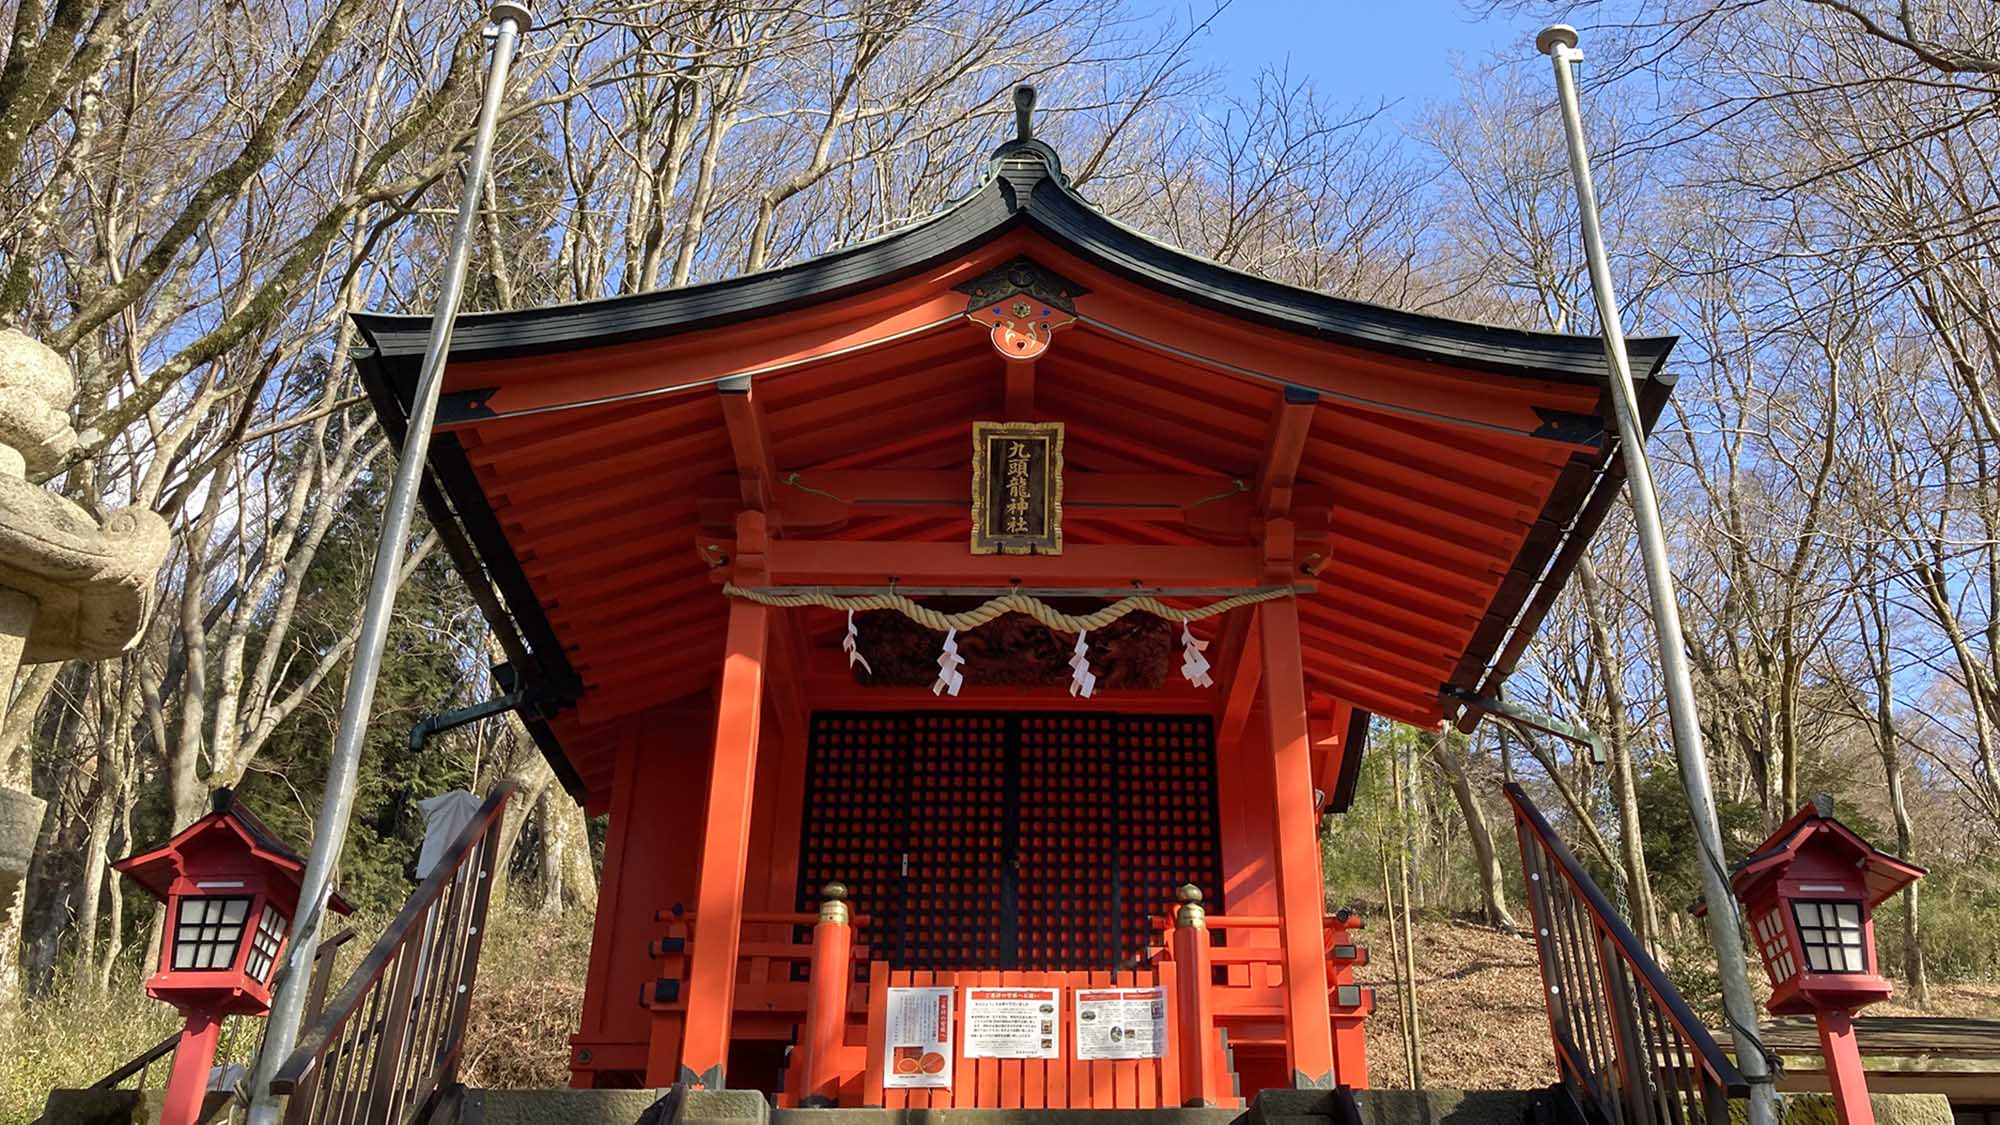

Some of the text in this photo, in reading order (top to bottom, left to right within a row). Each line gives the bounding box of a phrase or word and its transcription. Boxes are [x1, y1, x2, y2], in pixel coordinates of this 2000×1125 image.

[1006, 441, 1031, 533] 九頭龍神社
